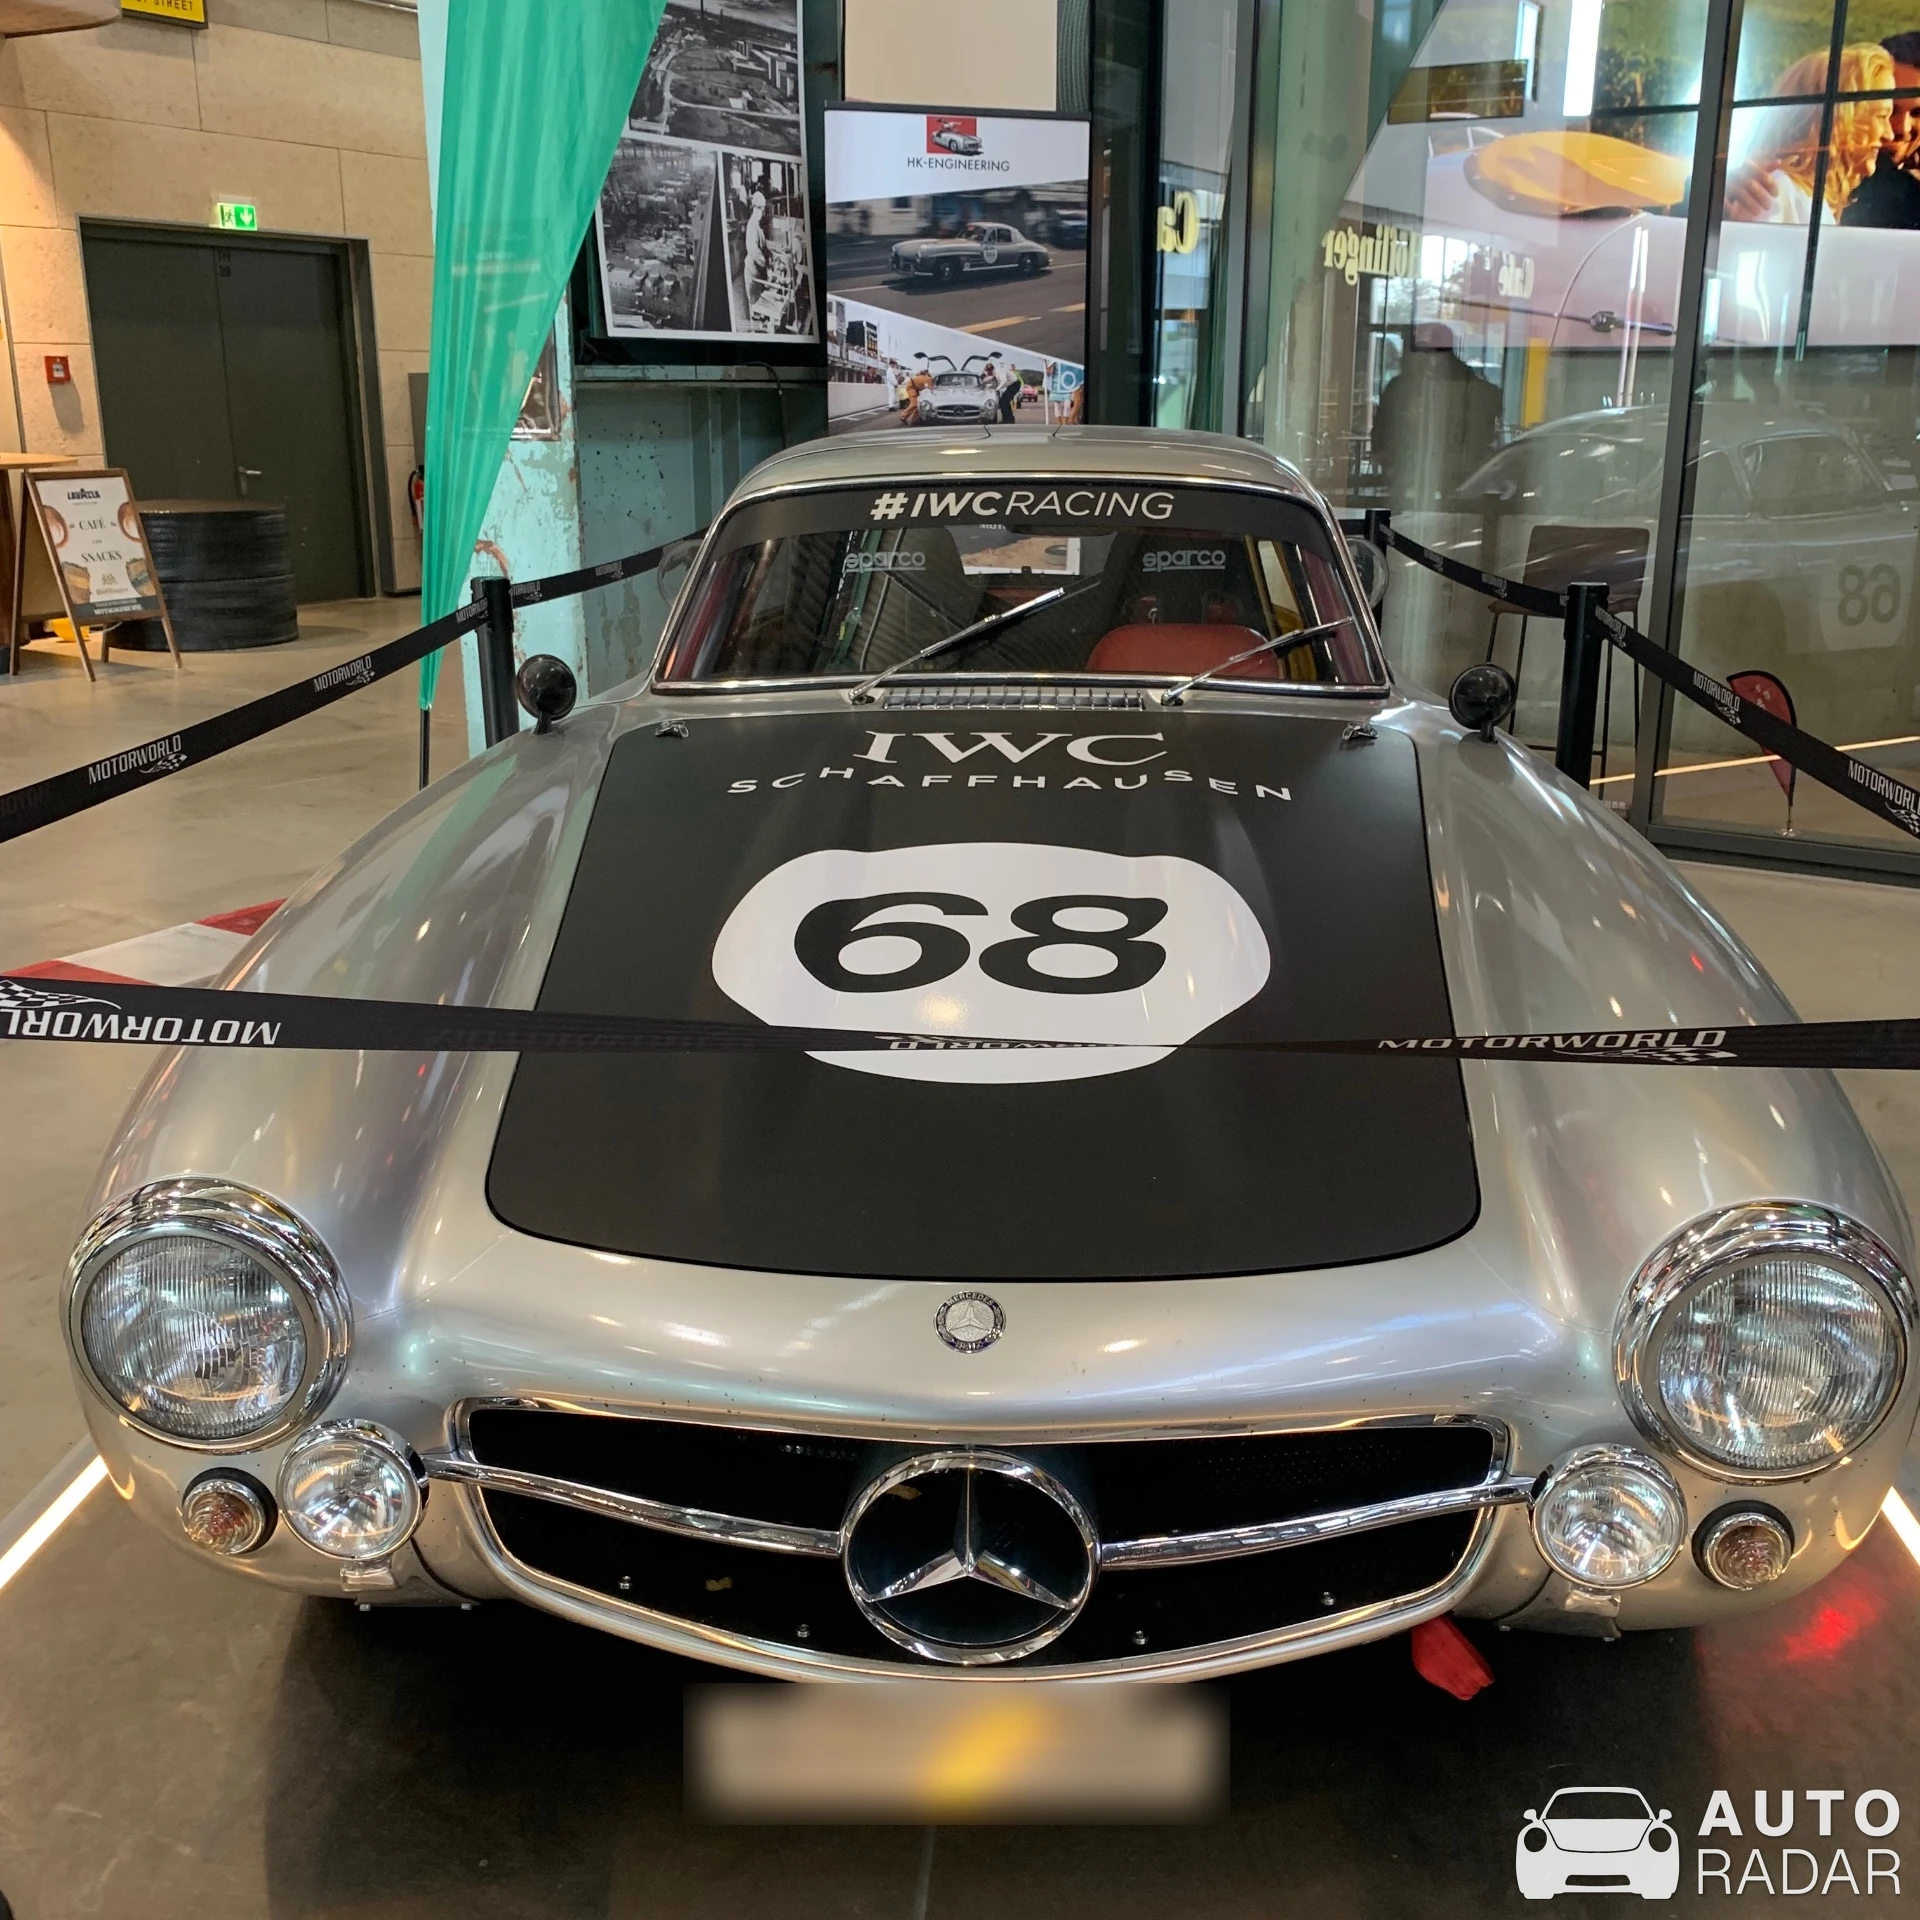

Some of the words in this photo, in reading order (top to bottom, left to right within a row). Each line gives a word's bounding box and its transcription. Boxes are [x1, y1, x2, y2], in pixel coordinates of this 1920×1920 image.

[906, 157, 1011, 172] HK-ENGINEERING
[78, 516, 107, 531] CAFÉ
[81, 550, 122, 563] SNACKS
[845, 551, 926, 570] sparco
[1142, 550, 1227, 570] sparco
[313, 655, 373, 693] MOTORWORLD
[1693, 671, 1741, 712] MOTORWORLD
[853, 731, 1168, 766] IWC
[88, 734, 182, 785] MOTORWORLD
[727, 767, 1292, 800] SCHAFFHAUSEN
[793, 891, 1169, 995] 68
[1377, 1030, 1727, 1049] MOTORWORLD
[946, 1292, 994, 1307] MERCEDES
